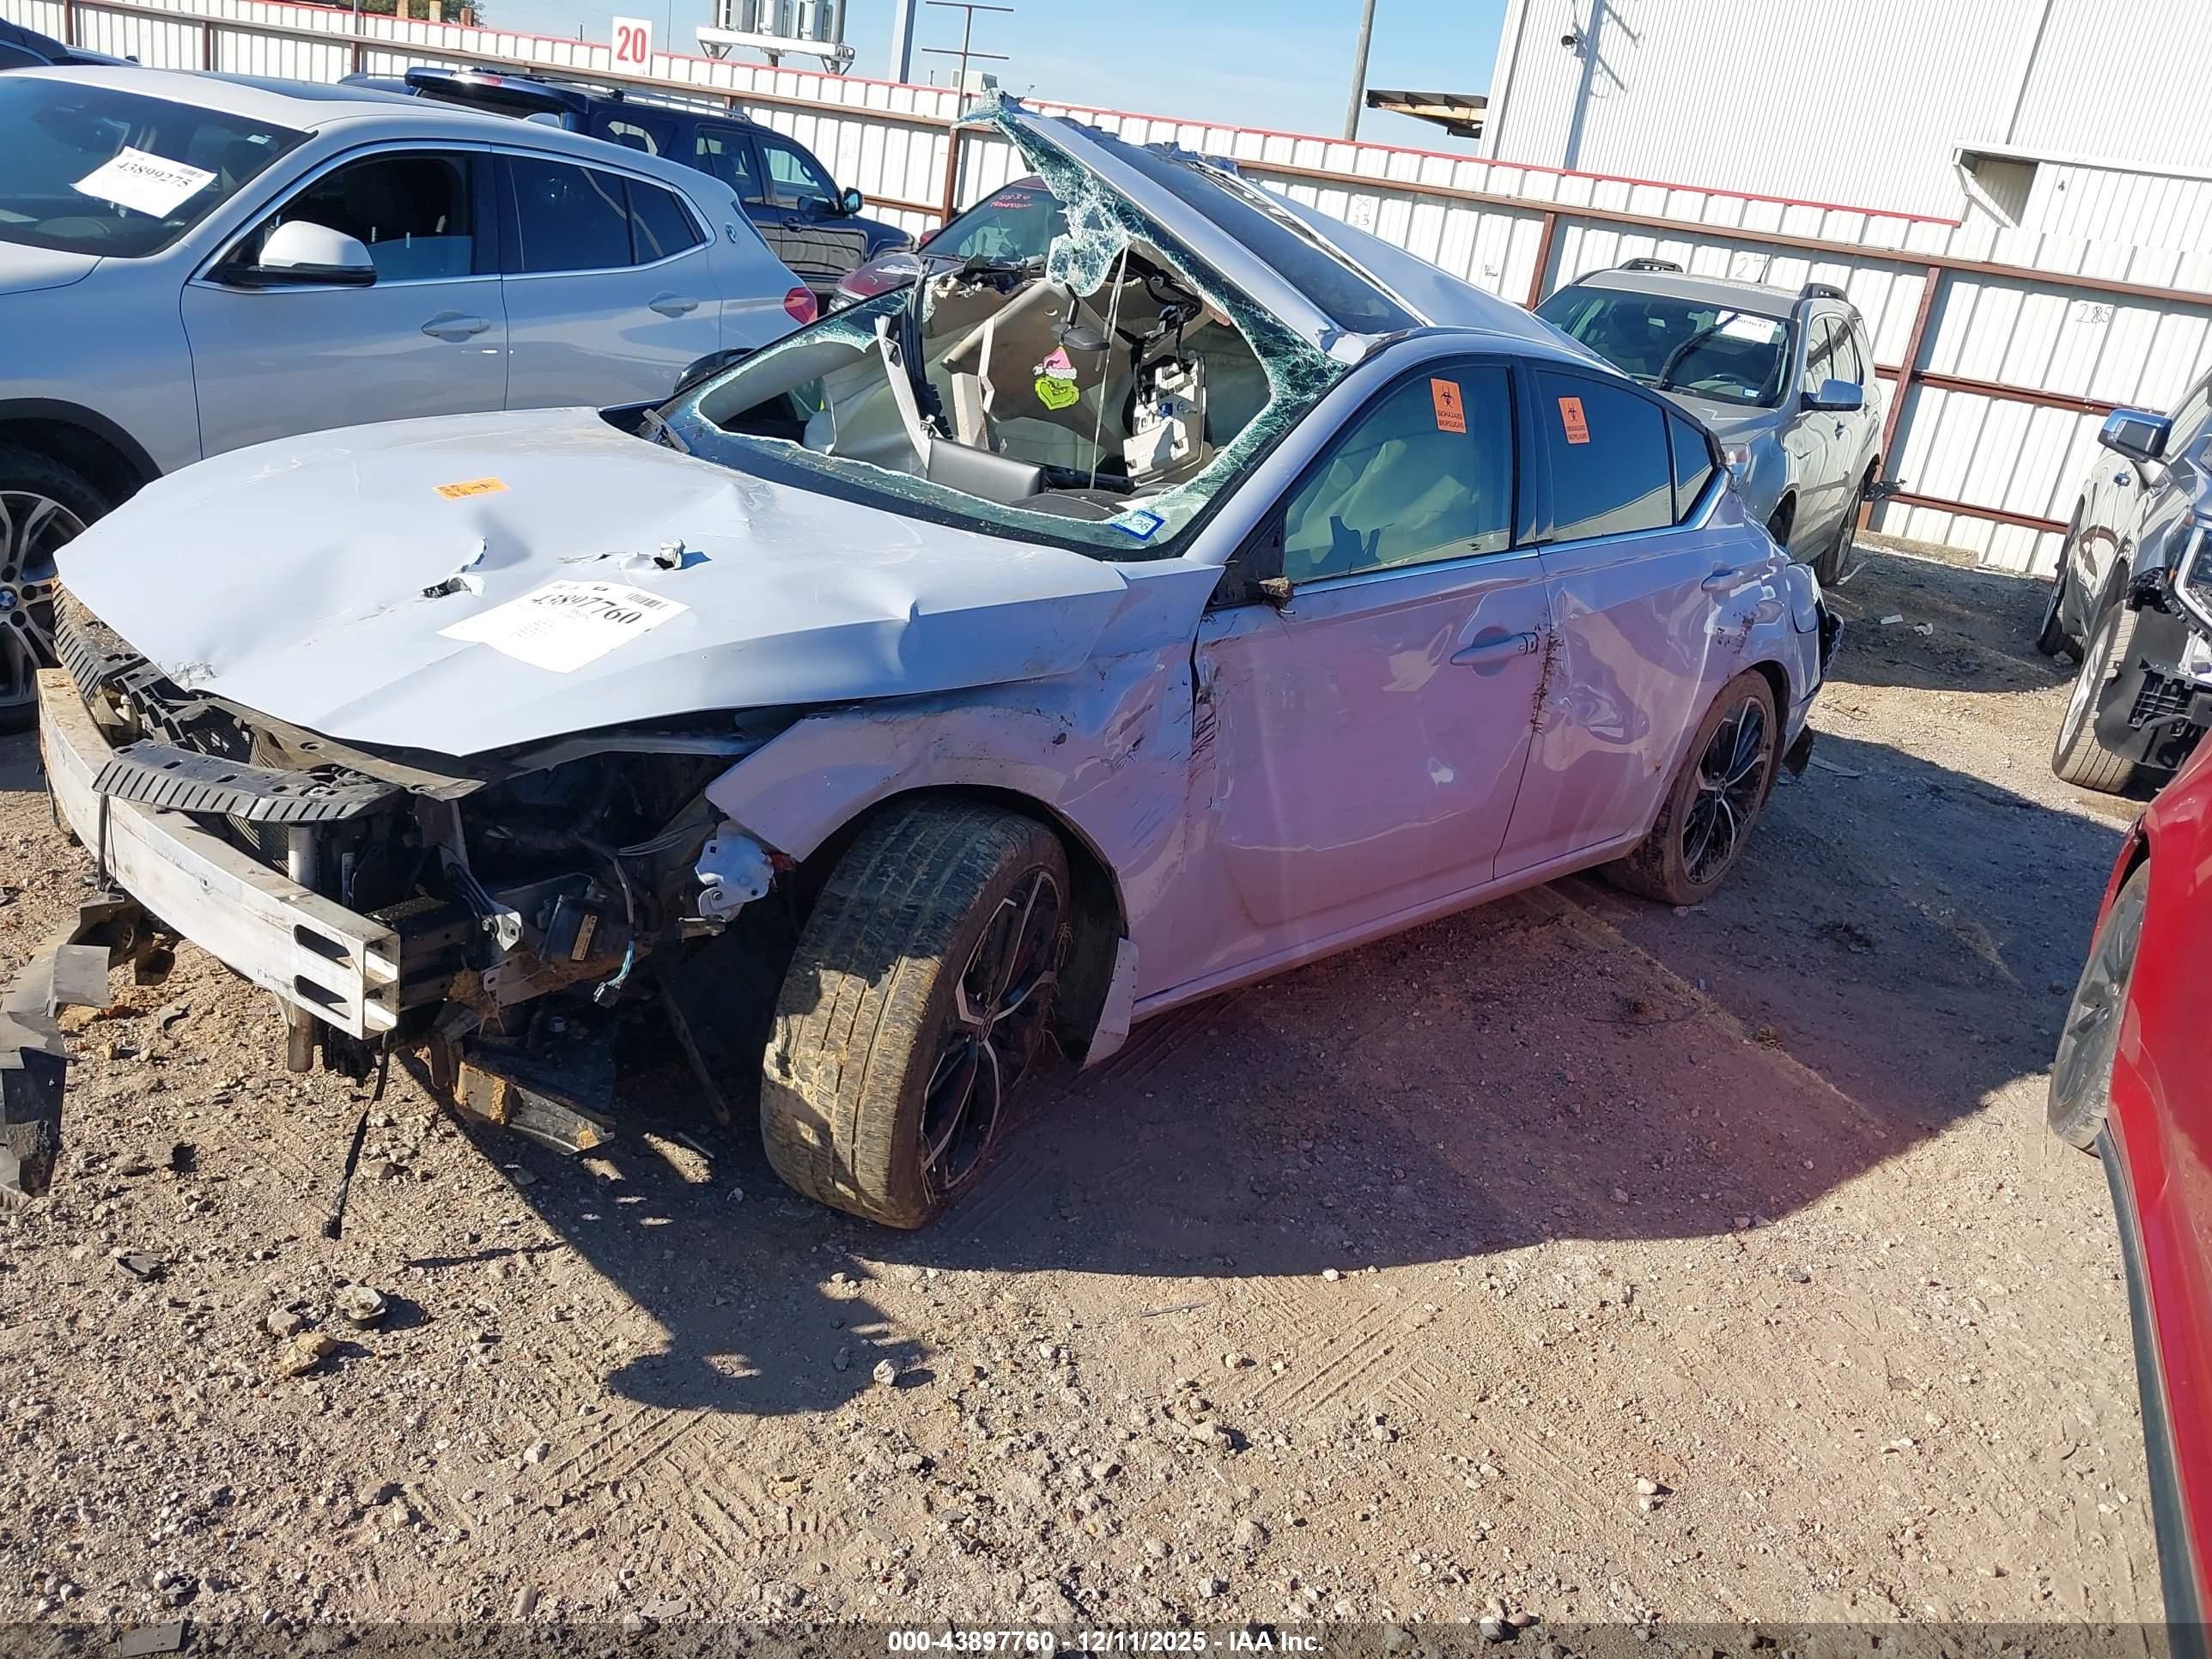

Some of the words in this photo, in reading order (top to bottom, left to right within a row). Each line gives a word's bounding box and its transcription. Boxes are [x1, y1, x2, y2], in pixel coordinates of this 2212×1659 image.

[617, 26, 647, 64] 20
[117, 161, 193, 187] 43899275
[530, 593, 642, 624] 43897760
